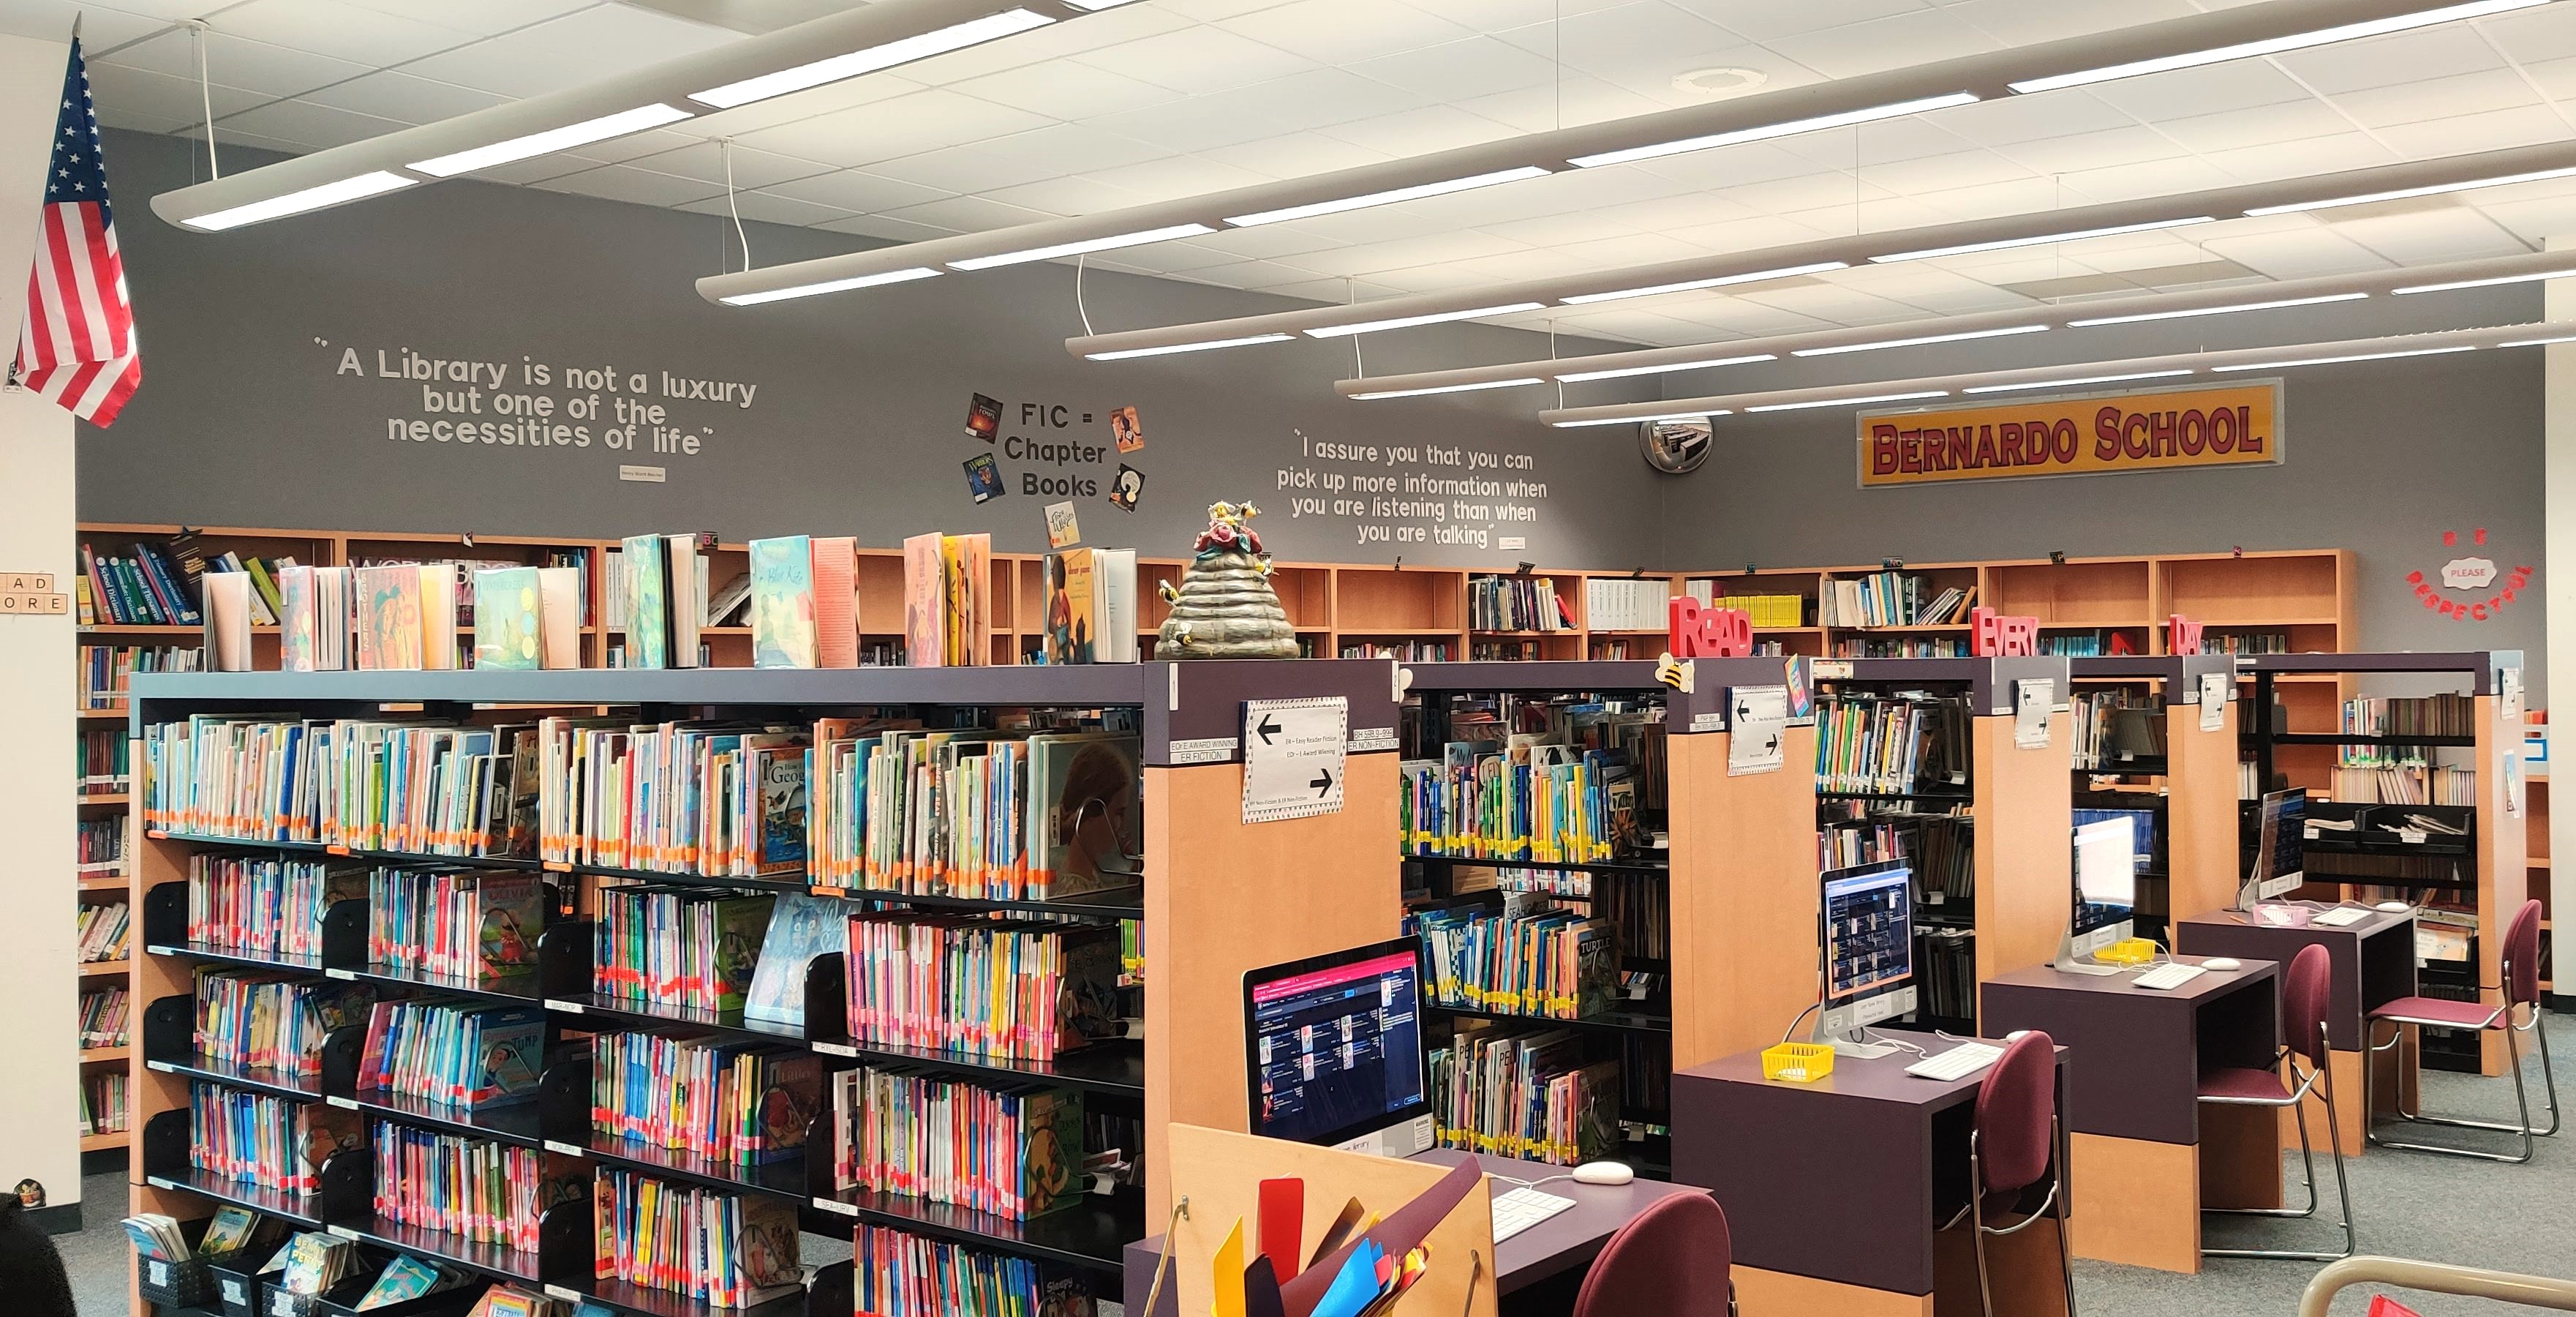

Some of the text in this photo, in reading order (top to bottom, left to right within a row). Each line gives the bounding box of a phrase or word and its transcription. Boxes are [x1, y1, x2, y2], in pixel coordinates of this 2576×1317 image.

[378, 347, 508, 390] Library
[524, 356, 551, 386] is
[565, 365, 617, 393] not
[629, 373, 647, 394] a
[662, 371, 757, 408] luxury
[423, 385, 666, 425] but one of the
[1022, 402, 1069, 429] FIC
[388, 417, 591, 448] necessities
[604, 426, 637, 451] of
[1872, 405, 2263, 476] BERNARDO SCHOOL
[1004, 436, 1107, 467] Chapter
[1315, 441, 1378, 462] assure
[1386, 446, 1417, 466] you
[1426, 444, 1461, 466] that
[1467, 449, 1499, 470] you
[1504, 452, 1534, 470] can
[1023, 473, 1097, 498] Books
[1277, 466, 1548, 498] pick up more information when
[1291, 496, 1537, 522] you are listening than when
[1357, 522, 1390, 544] you
[1396, 525, 1426, 543] are
[2451, 568, 2486, 578] PLEASE
[1670, 596, 1753, 658] READ
[1972, 607, 2039, 657] EVERY
[2169, 613, 2204, 656] DAY
[1180, 751, 1223, 762] ER FICTION
[1189, 740, 1211, 749] AWARD
[1211, 739, 1238, 748] WINNING
[1348, 739, 1399, 751] ER NON-FICTION
